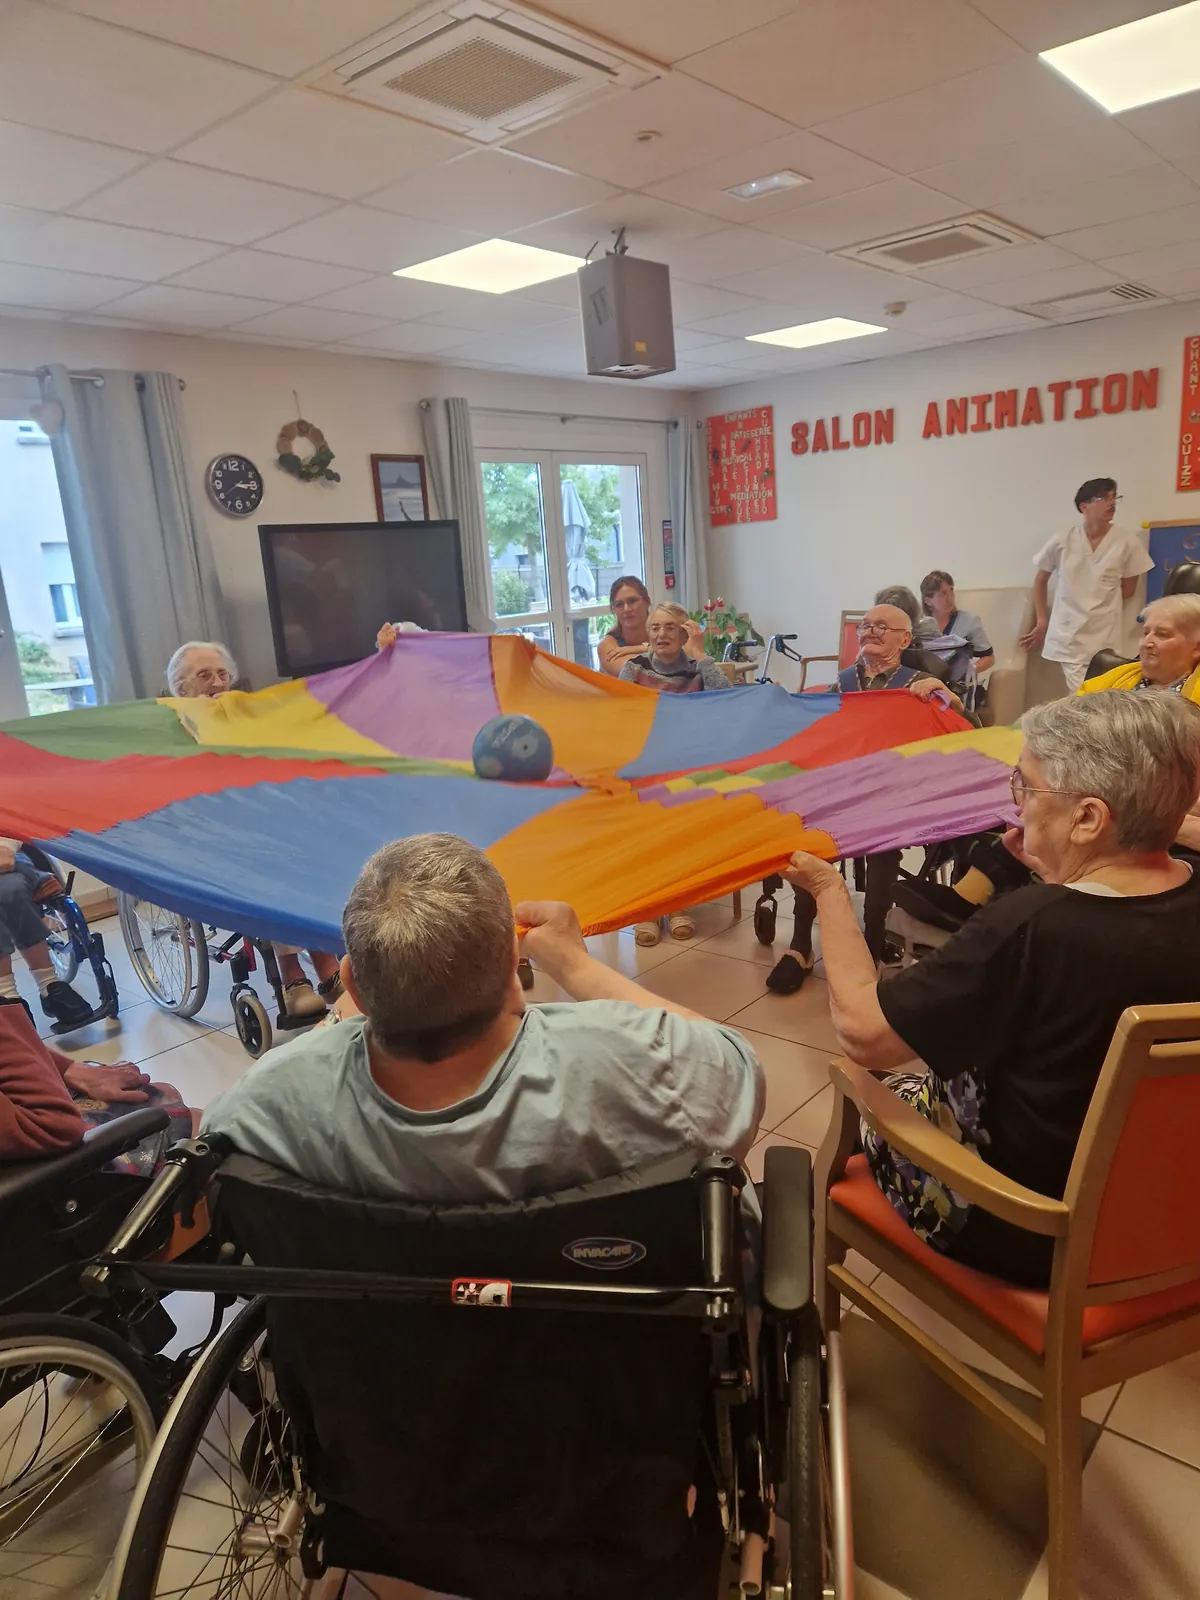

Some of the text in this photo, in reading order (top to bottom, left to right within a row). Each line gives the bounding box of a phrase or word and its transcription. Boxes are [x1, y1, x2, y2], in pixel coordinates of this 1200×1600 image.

[1189, 338, 1200, 396] CHANT
[791, 368, 1160, 456] SALON ANIMATION
[228, 460, 239, 471] 12
[214, 479, 222, 489] 9
[250, 480, 258, 490] 3
[730, 489, 773, 501] MEDIATION
[235, 499, 243, 510] 6
